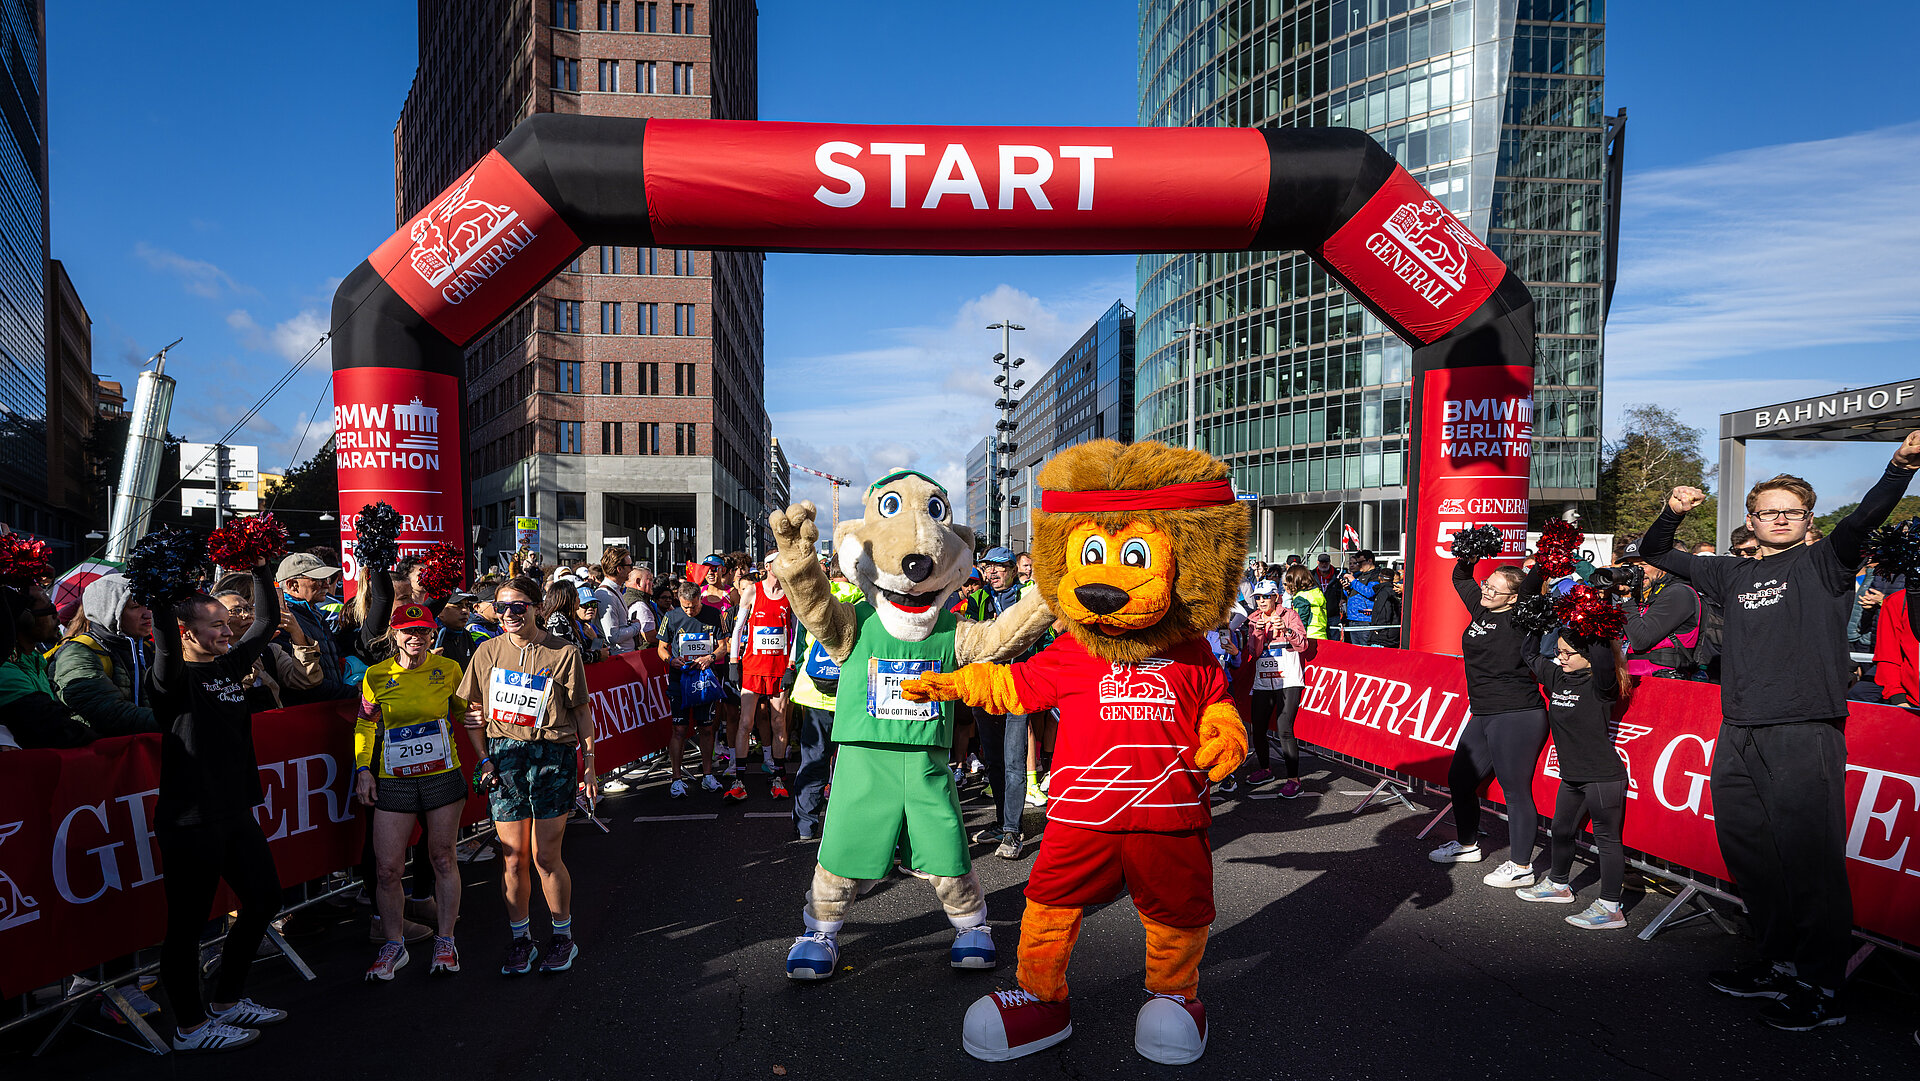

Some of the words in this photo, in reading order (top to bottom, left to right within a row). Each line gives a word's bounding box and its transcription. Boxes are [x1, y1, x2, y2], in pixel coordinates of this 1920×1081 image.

[813, 141, 1114, 211] START
[441, 219, 538, 305] GENERALI
[1365, 232, 1454, 310] GENERALI
[334, 403, 389, 431] BMW
[1442, 398, 1516, 423] BMW
[1755, 384, 1915, 429] BAHNHOF
[335, 431, 391, 450] BERLIN
[1441, 423, 1515, 440] BERLIN
[1260, 660, 1279, 668] 4593
[495, 690, 538, 709] GUIDE
[587, 673, 672, 744] ENERAL
[877, 707, 890, 715] YOU
[891, 708, 903, 716] GOT
[904, 708, 918, 717] THIS
[1099, 705, 1176, 722] GENERALI
[399, 742, 434, 759] 2199
